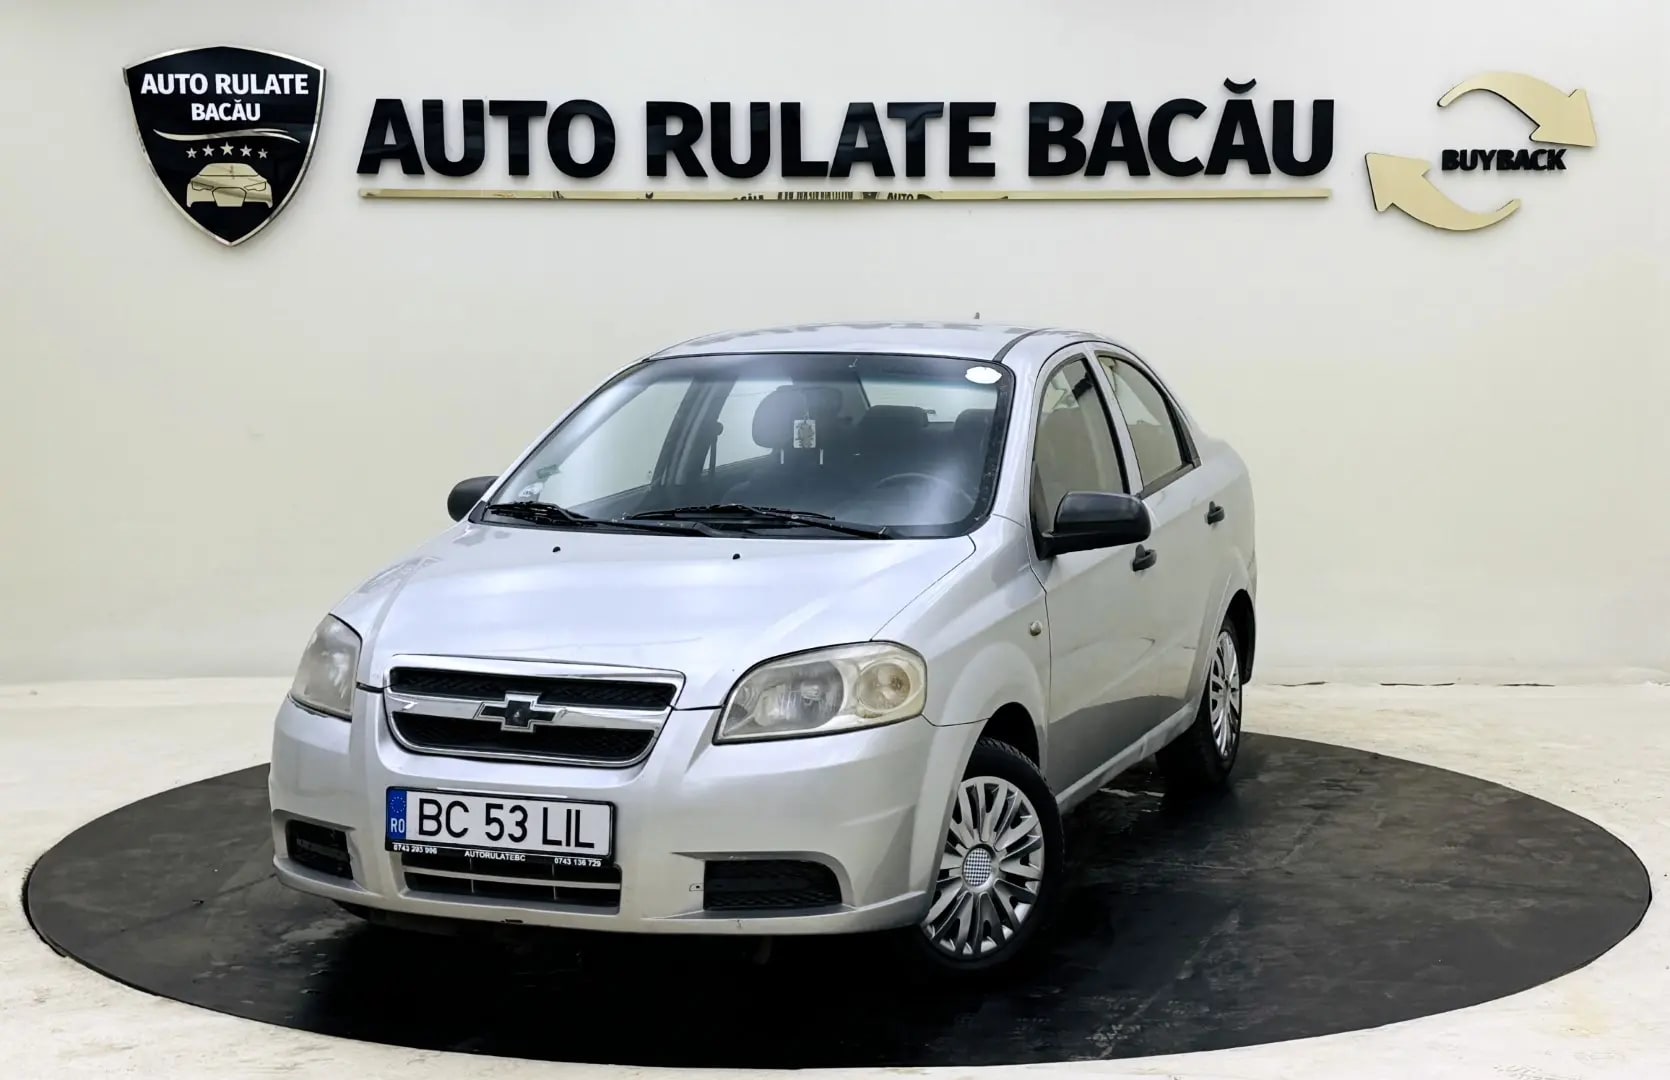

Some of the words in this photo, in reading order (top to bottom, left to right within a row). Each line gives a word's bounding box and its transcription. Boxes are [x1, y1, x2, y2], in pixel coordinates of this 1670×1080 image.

[141, 73, 208, 94] AUTO
[215, 73, 309, 94] RULATE
[191, 99, 261, 121] BACĂU
[357, 98, 616, 177] AUTO
[646, 101, 997, 178] RULATE
[1027, 78, 1334, 177] BACĂU
[1441, 149, 1567, 171] BUYBACK
[390, 818, 405, 833] RO
[418, 798, 469, 838] BC
[485, 803, 528, 843] 53
[542, 807, 594, 848] LIL
[464, 850, 526, 861] AUTORULATEBC
[554, 857, 571, 865] 0743
